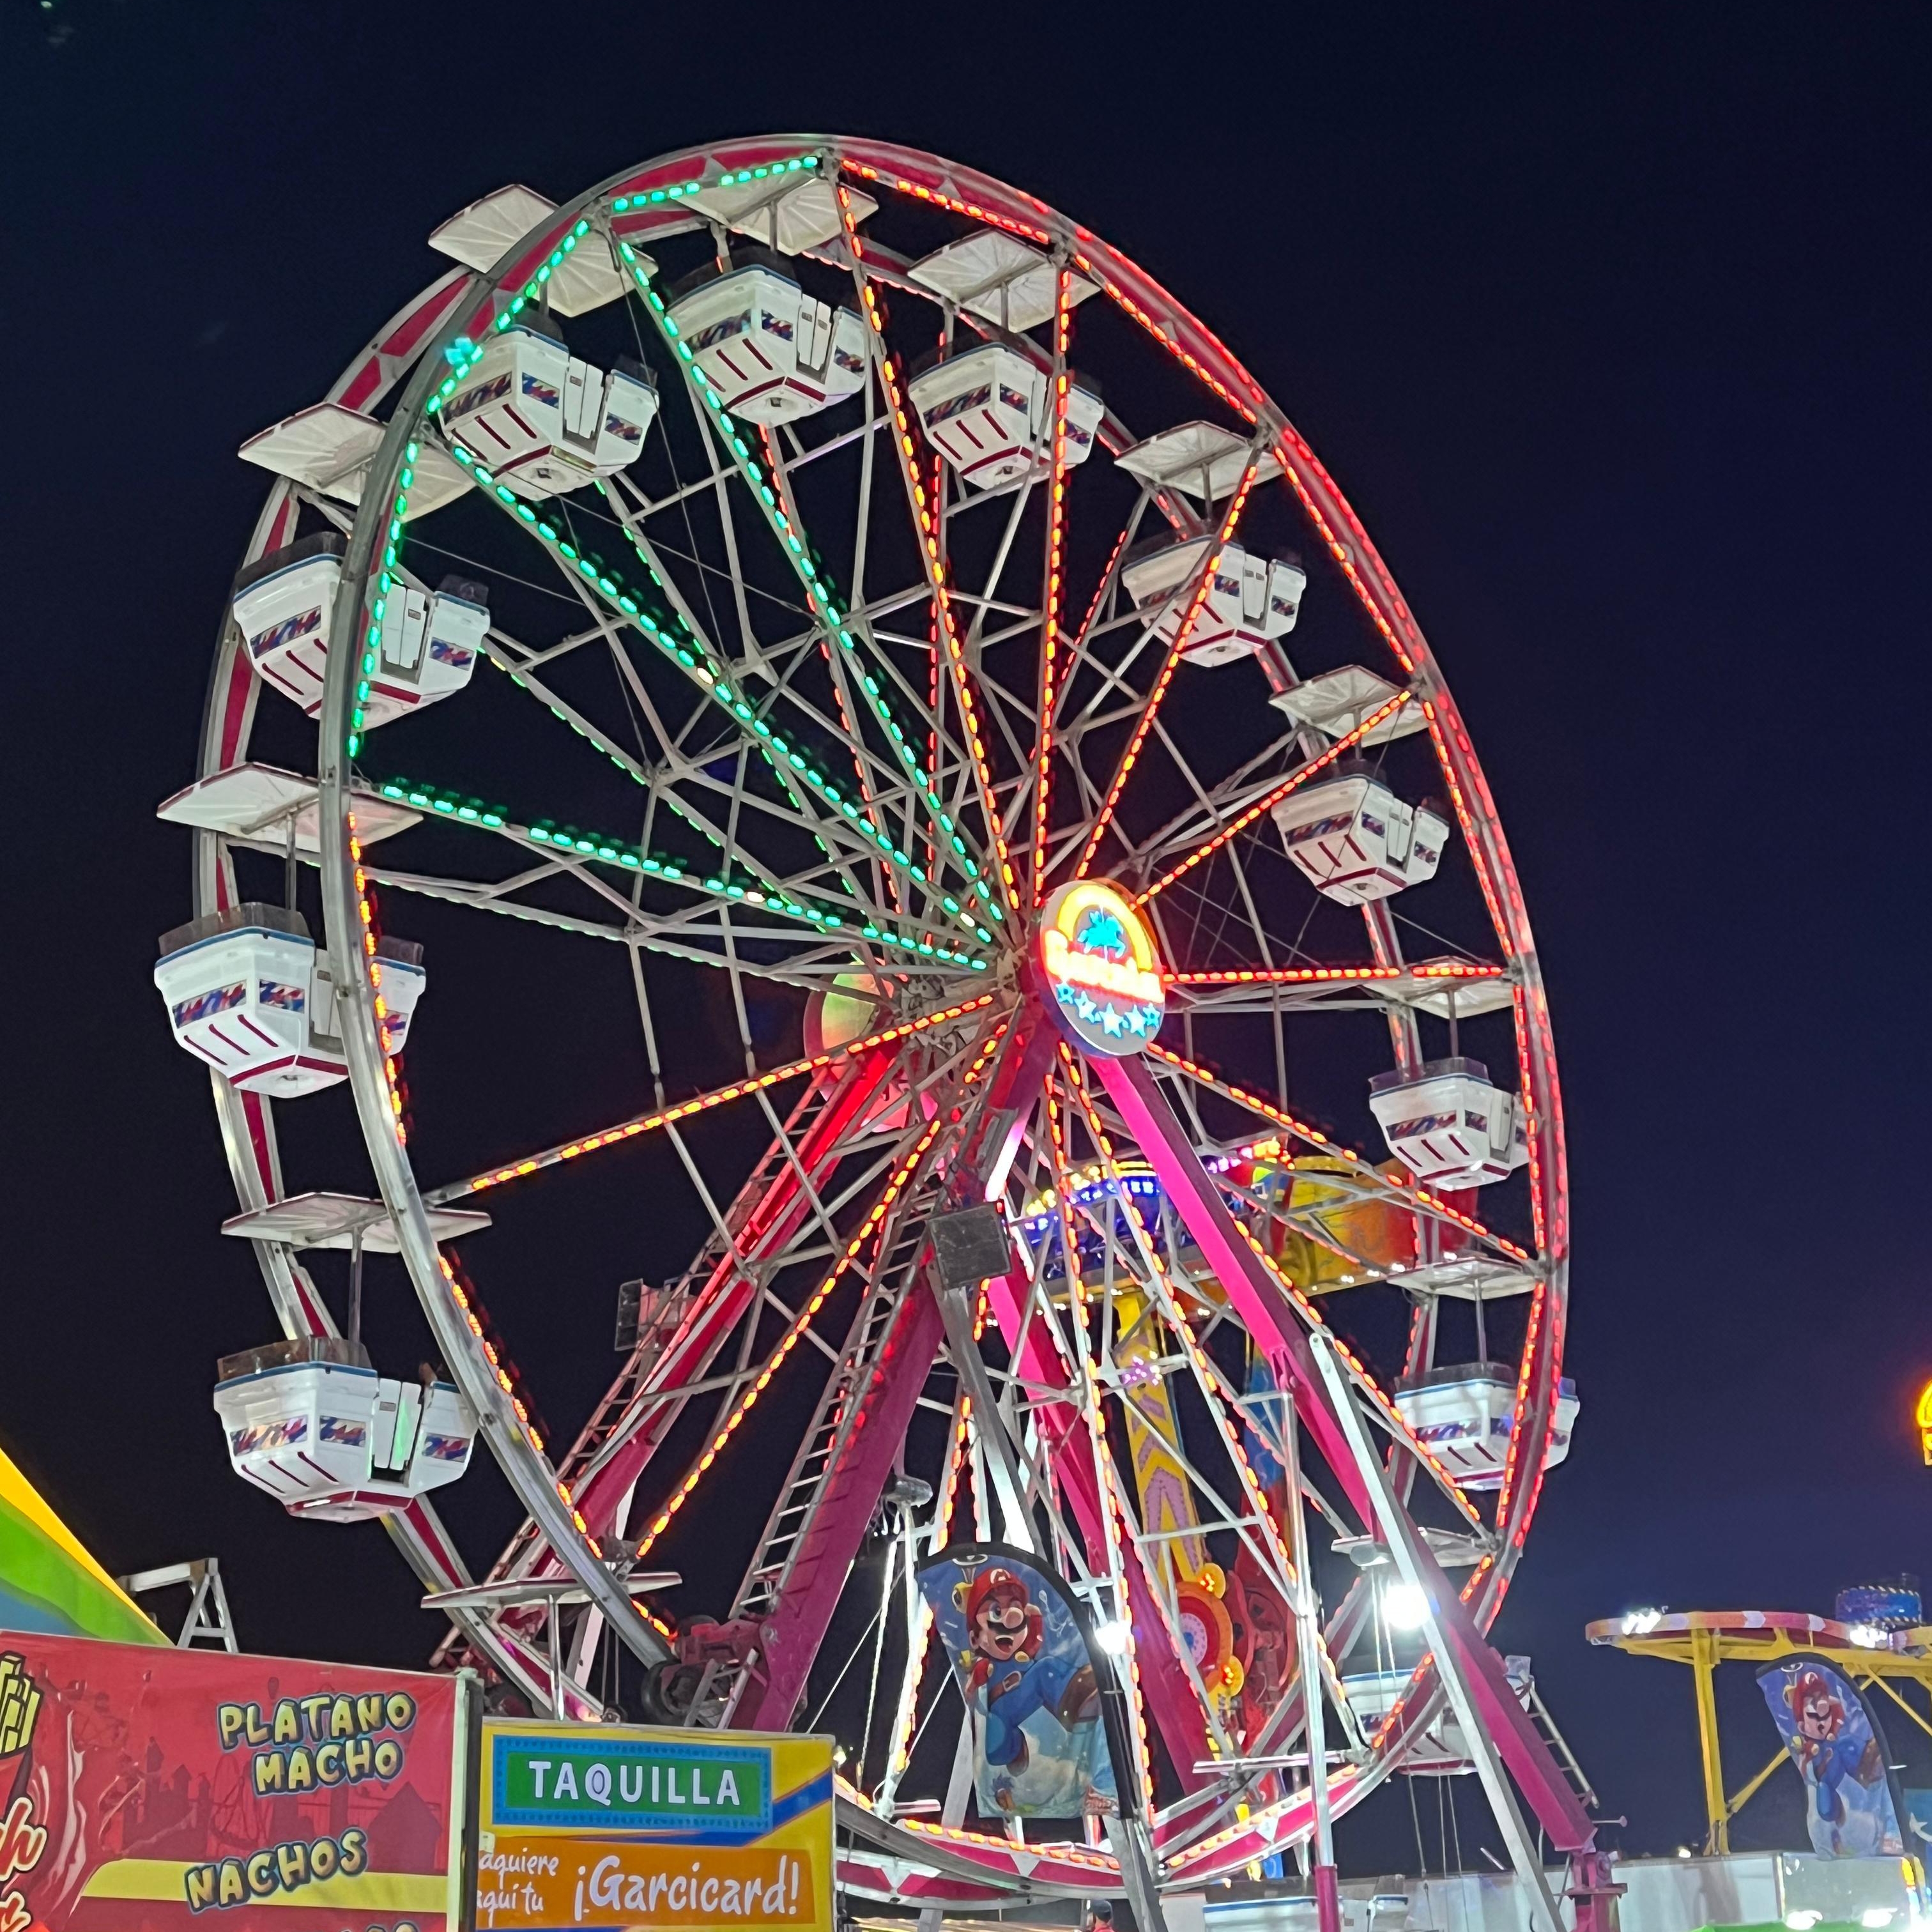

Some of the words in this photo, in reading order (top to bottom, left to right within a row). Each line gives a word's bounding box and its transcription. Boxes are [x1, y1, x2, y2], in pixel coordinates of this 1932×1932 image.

[219, 1693, 416, 1749] PLATANO
[255, 1738, 403, 1795] MACHO
[528, 1761, 740, 1805] TAQUILLA
[185, 1828, 367, 1911] NACHOS
[574, 1855, 799, 1921] ¡Garcicard!
[520, 1881, 544, 1915] tu
